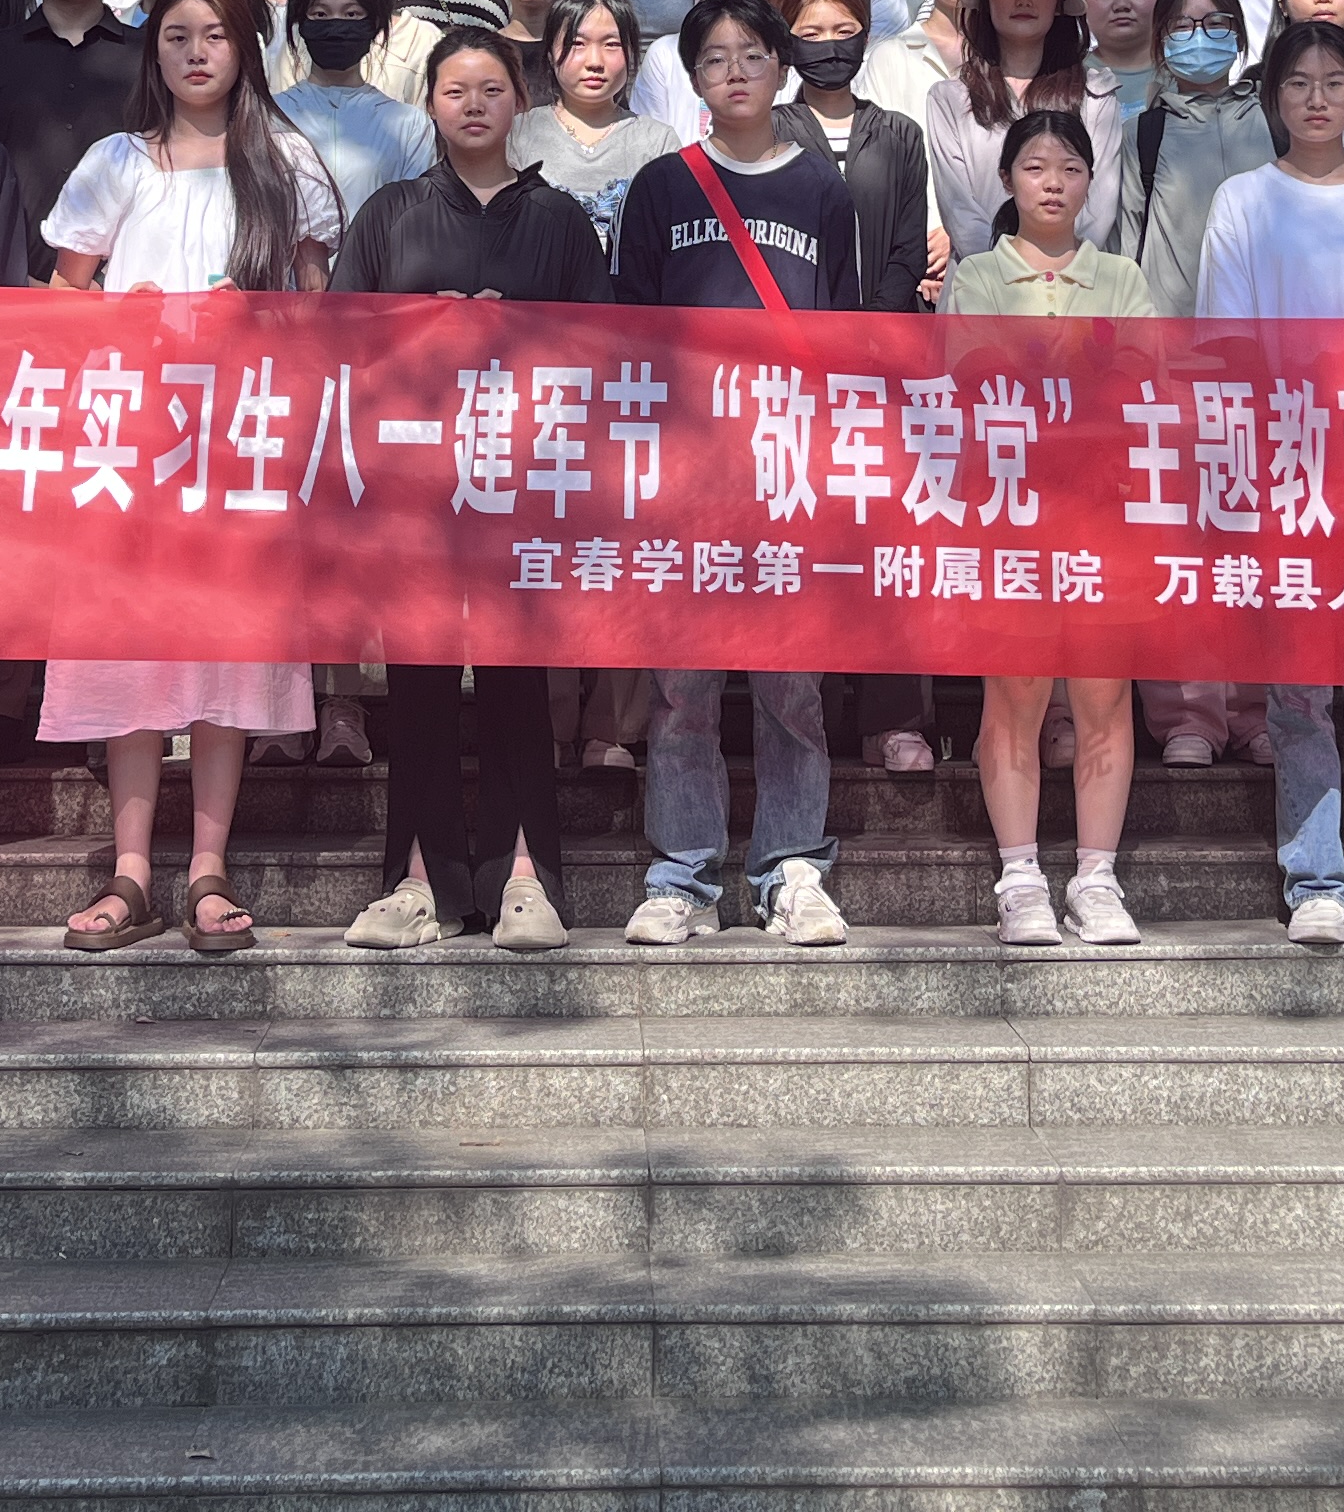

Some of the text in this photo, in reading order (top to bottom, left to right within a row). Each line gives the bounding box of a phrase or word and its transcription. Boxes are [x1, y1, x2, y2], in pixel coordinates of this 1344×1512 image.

[509, 537, 1104, 604] 宜春学院第一附属医院
